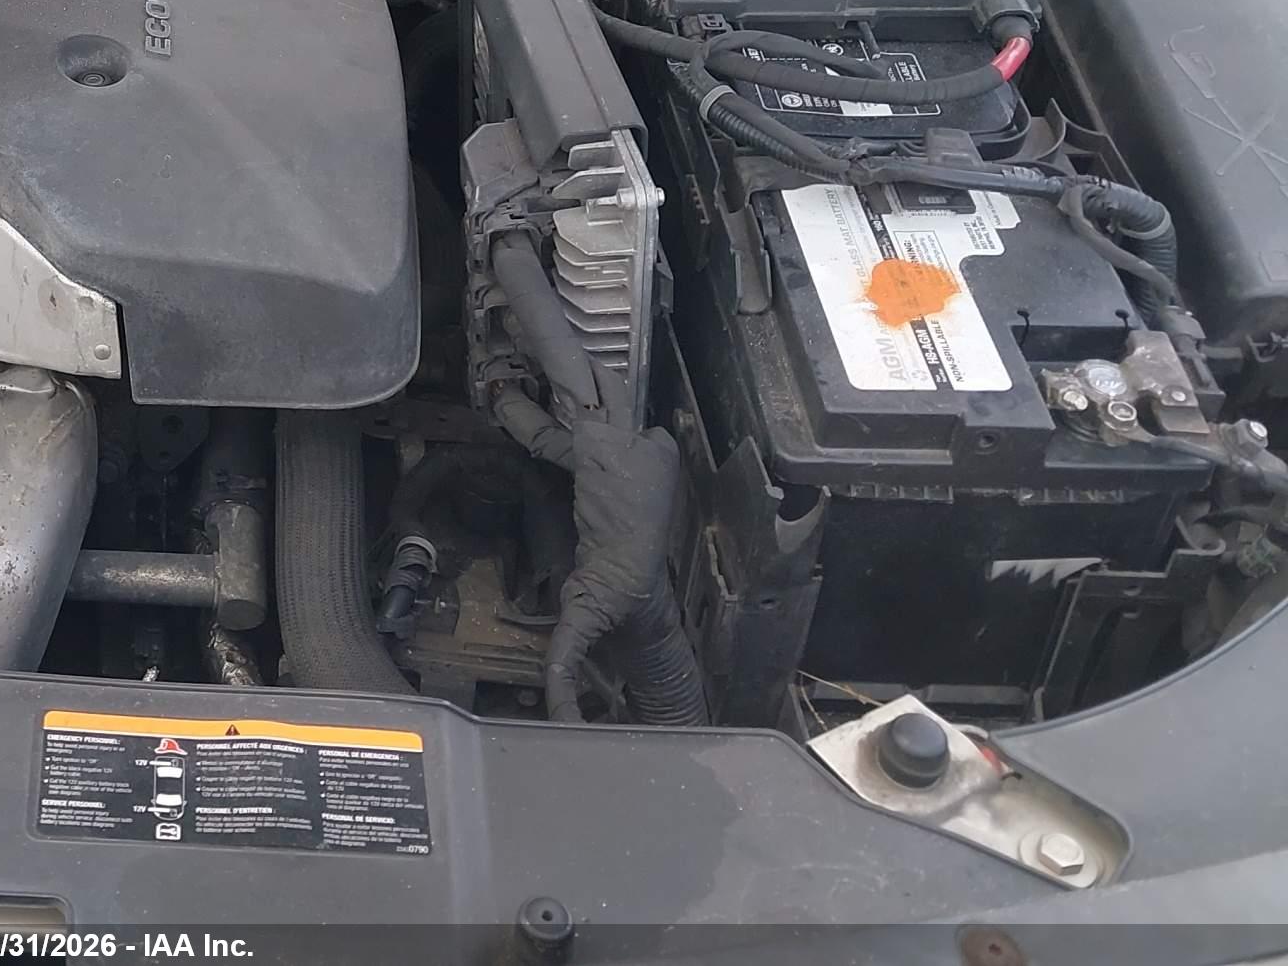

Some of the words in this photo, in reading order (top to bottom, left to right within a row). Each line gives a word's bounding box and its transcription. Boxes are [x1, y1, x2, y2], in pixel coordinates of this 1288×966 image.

[824, 186, 847, 226] BATTERY
[839, 226, 857, 247] MAT
[847, 248, 867, 278] GLASS
[875, 338, 907, 381] AGM
[930, 319, 965, 383] NON-SPILLABLE
[132, 805, 146, 813] 12V
